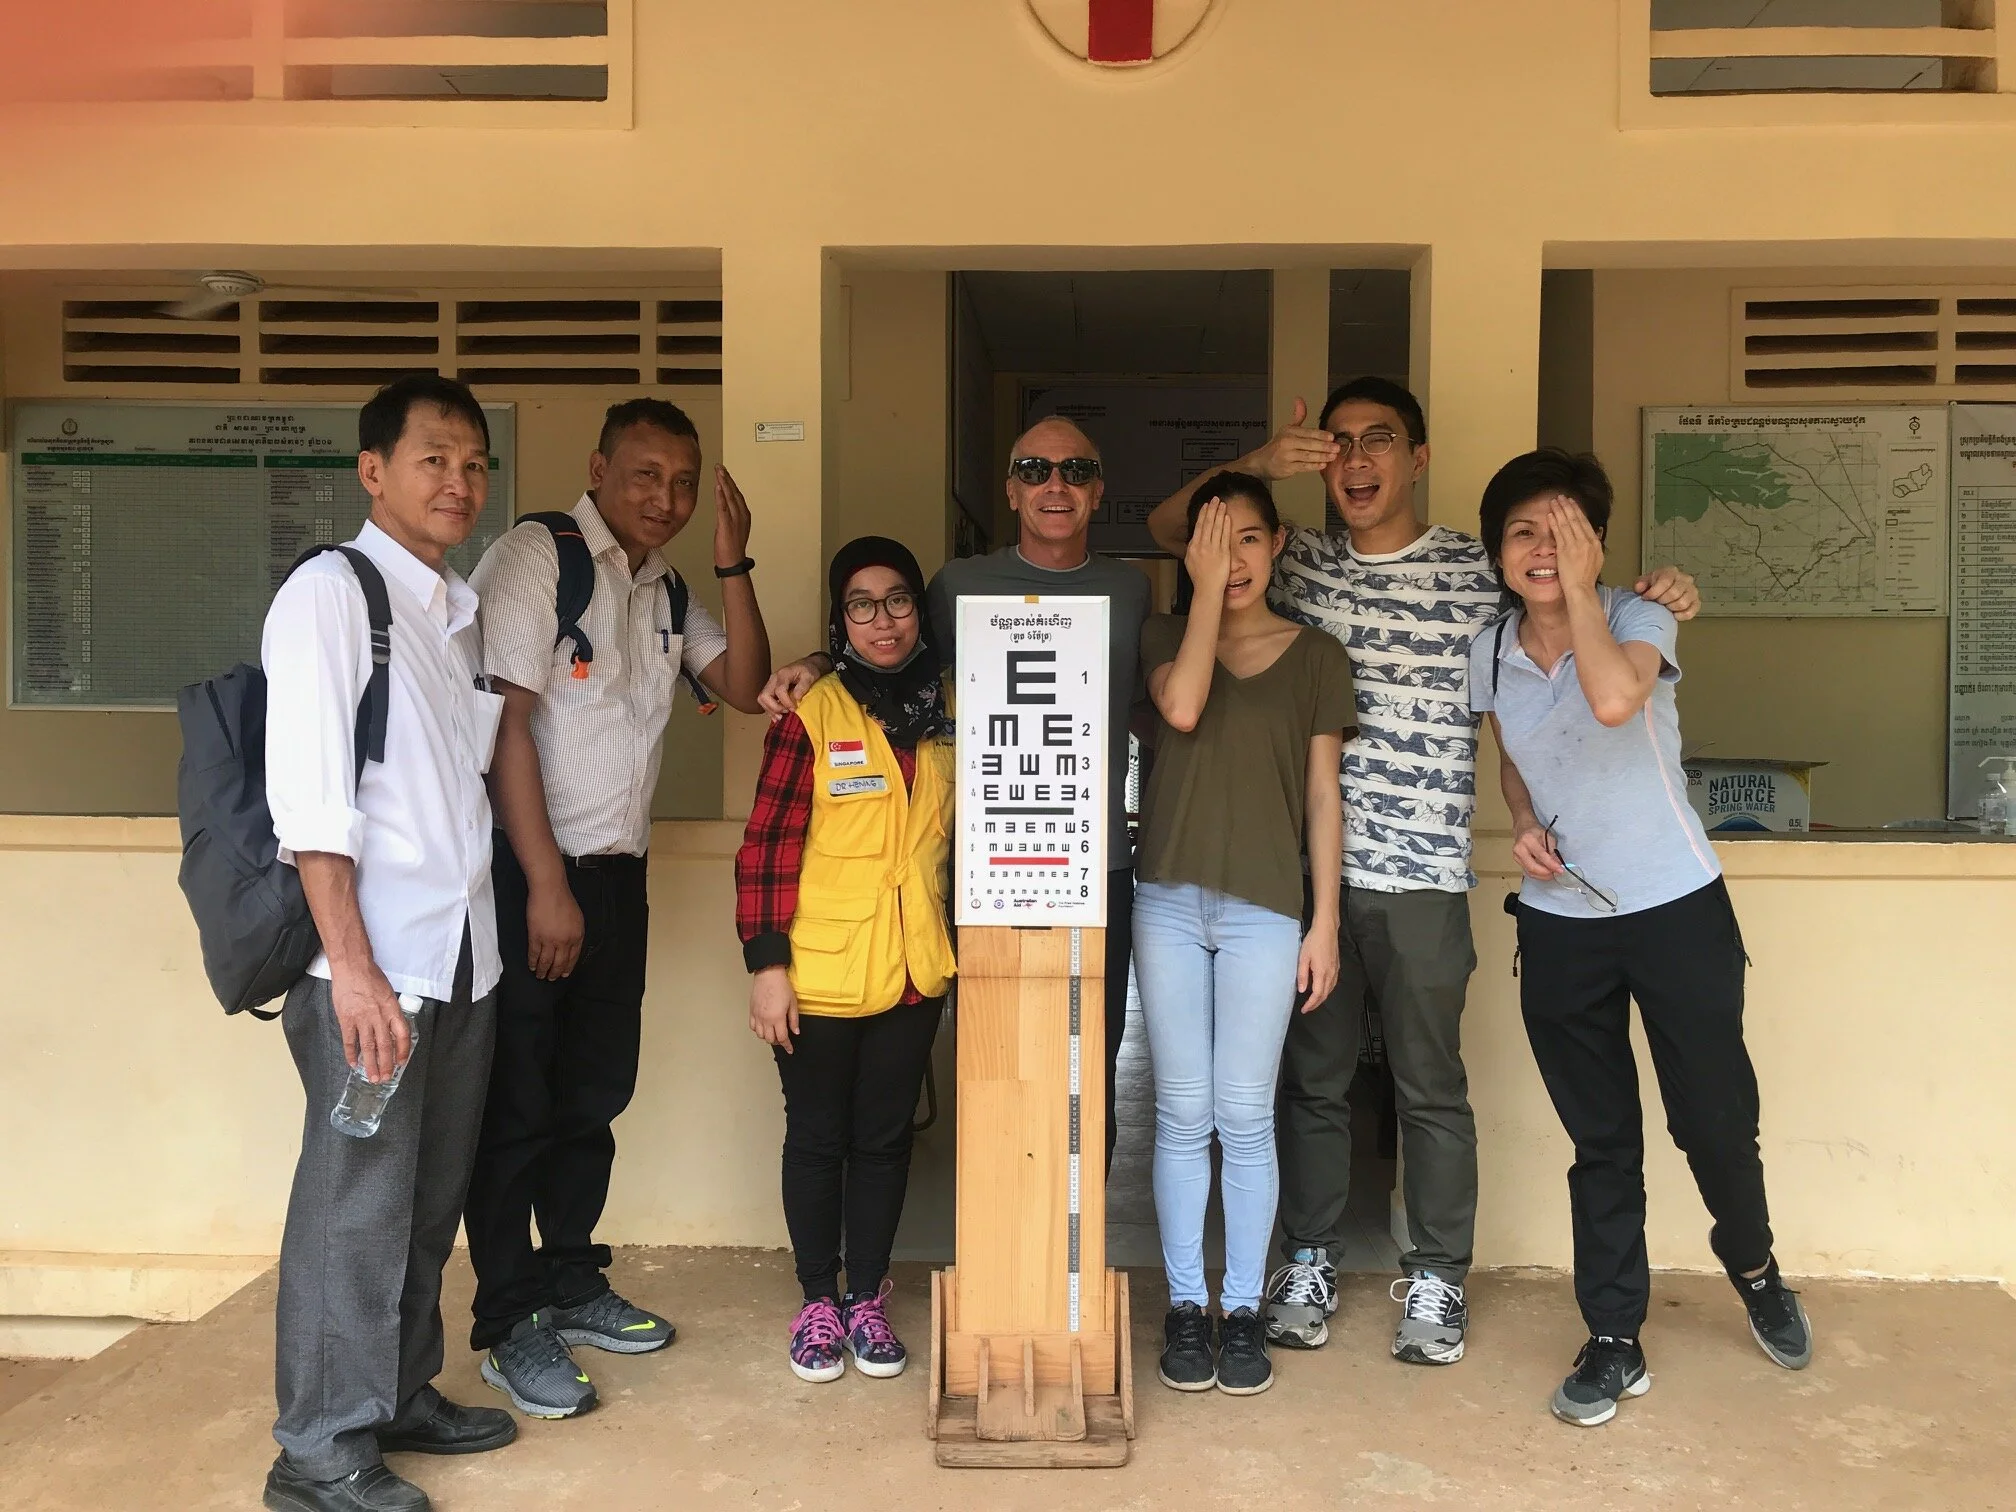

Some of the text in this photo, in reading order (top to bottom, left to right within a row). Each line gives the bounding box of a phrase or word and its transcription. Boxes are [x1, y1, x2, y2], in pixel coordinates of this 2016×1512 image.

[1081, 671, 1088, 684] 1
[1081, 723, 1091, 736] 2
[1081, 757, 1091, 770] 3
[1709, 774, 1776, 793] NATURAL
[1080, 787, 1091, 800] 4
[1708, 788, 1775, 806] SOURCE
[1708, 802, 1775, 815] SPRING WATER
[1081, 820, 1090, 833] 5
[1080, 840, 1089, 853] 6
[1080, 868, 1089, 880] 7
[1080, 884, 1089, 897] 8
